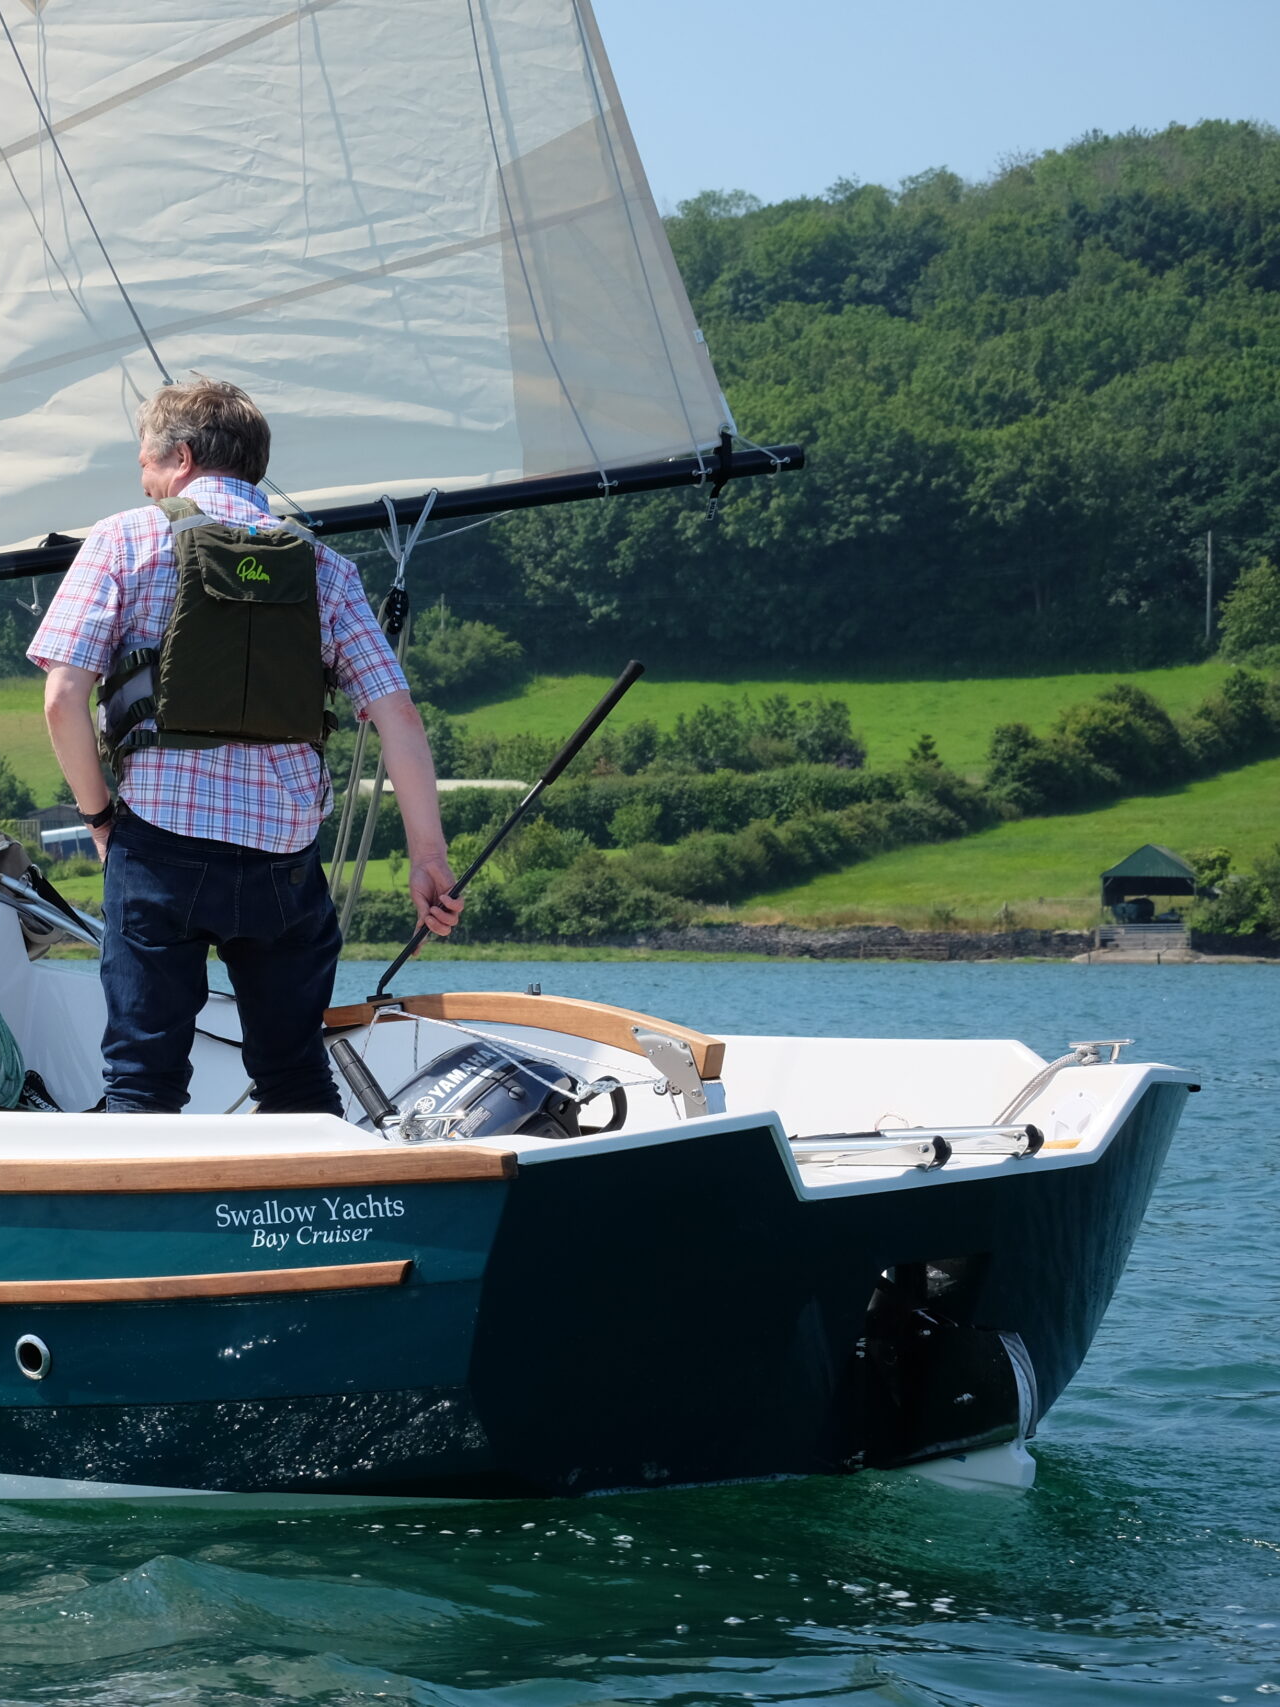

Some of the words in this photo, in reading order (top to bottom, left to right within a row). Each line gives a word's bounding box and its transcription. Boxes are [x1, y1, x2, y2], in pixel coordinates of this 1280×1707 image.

[236, 556, 271, 584] Palm
[427, 1049, 497, 1098] YAMAHA
[215, 1199, 317, 1228] Swallow
[322, 1193, 405, 1221] Yachts
[251, 1228, 290, 1252] Bay
[296, 1224, 373, 1245] Cruiser
